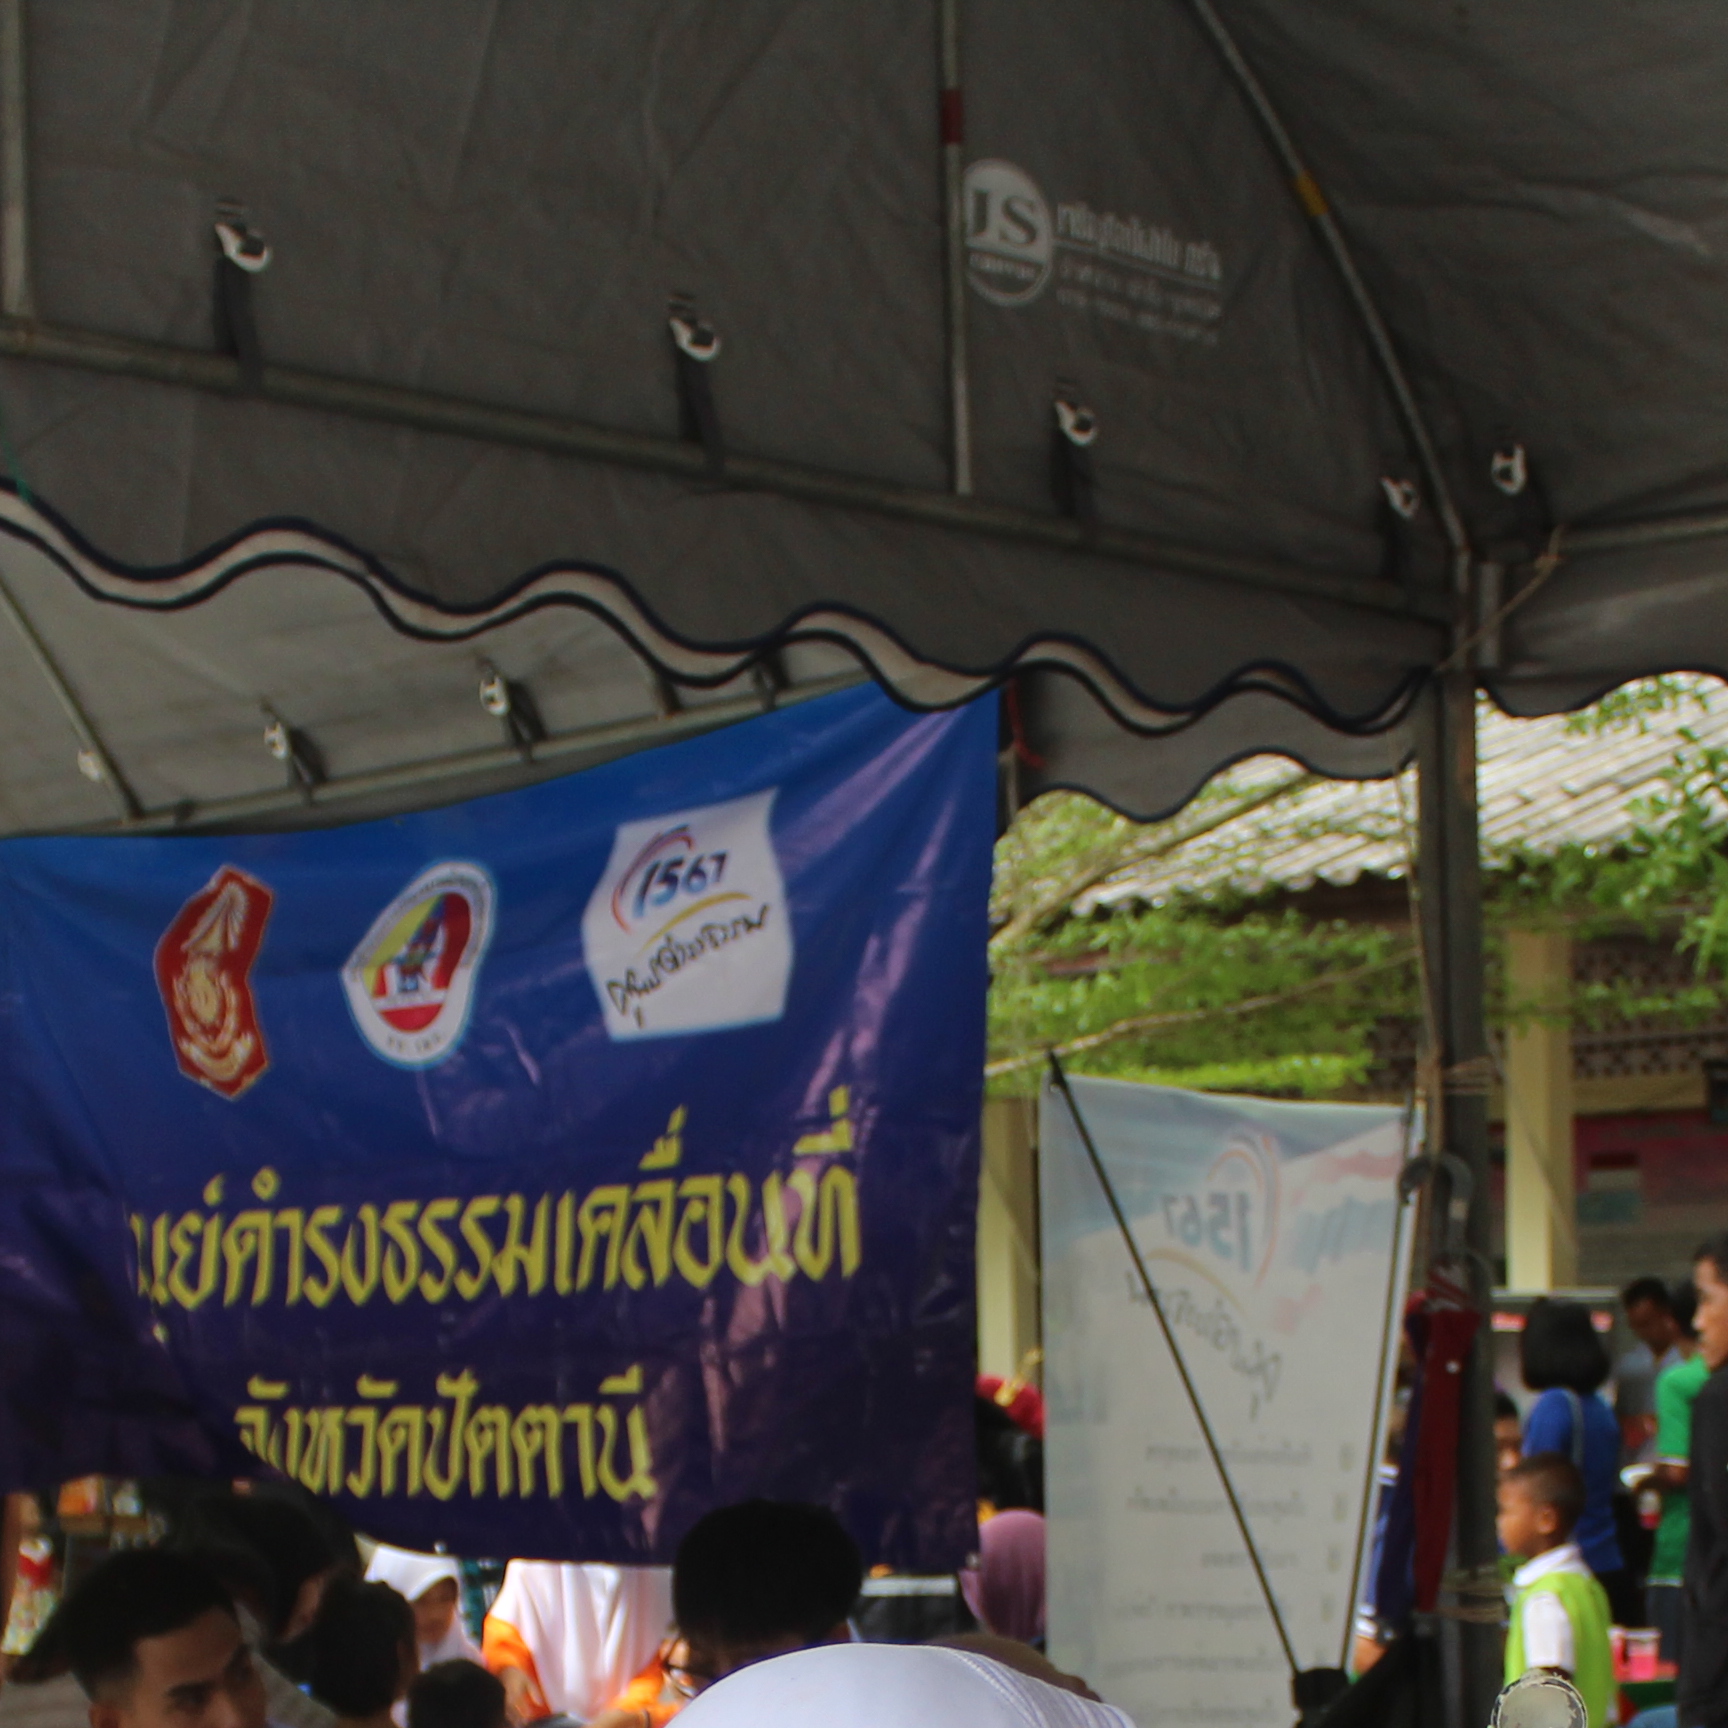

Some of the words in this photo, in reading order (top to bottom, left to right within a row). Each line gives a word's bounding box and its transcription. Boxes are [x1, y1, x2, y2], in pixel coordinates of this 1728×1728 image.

[632, 850, 728, 919] 1567
[128, 1083, 863, 1312] นย์ดำรงธรรมเคลื่อนที่
[233, 1362, 659, 1502] จังหวัดปัตตานี
